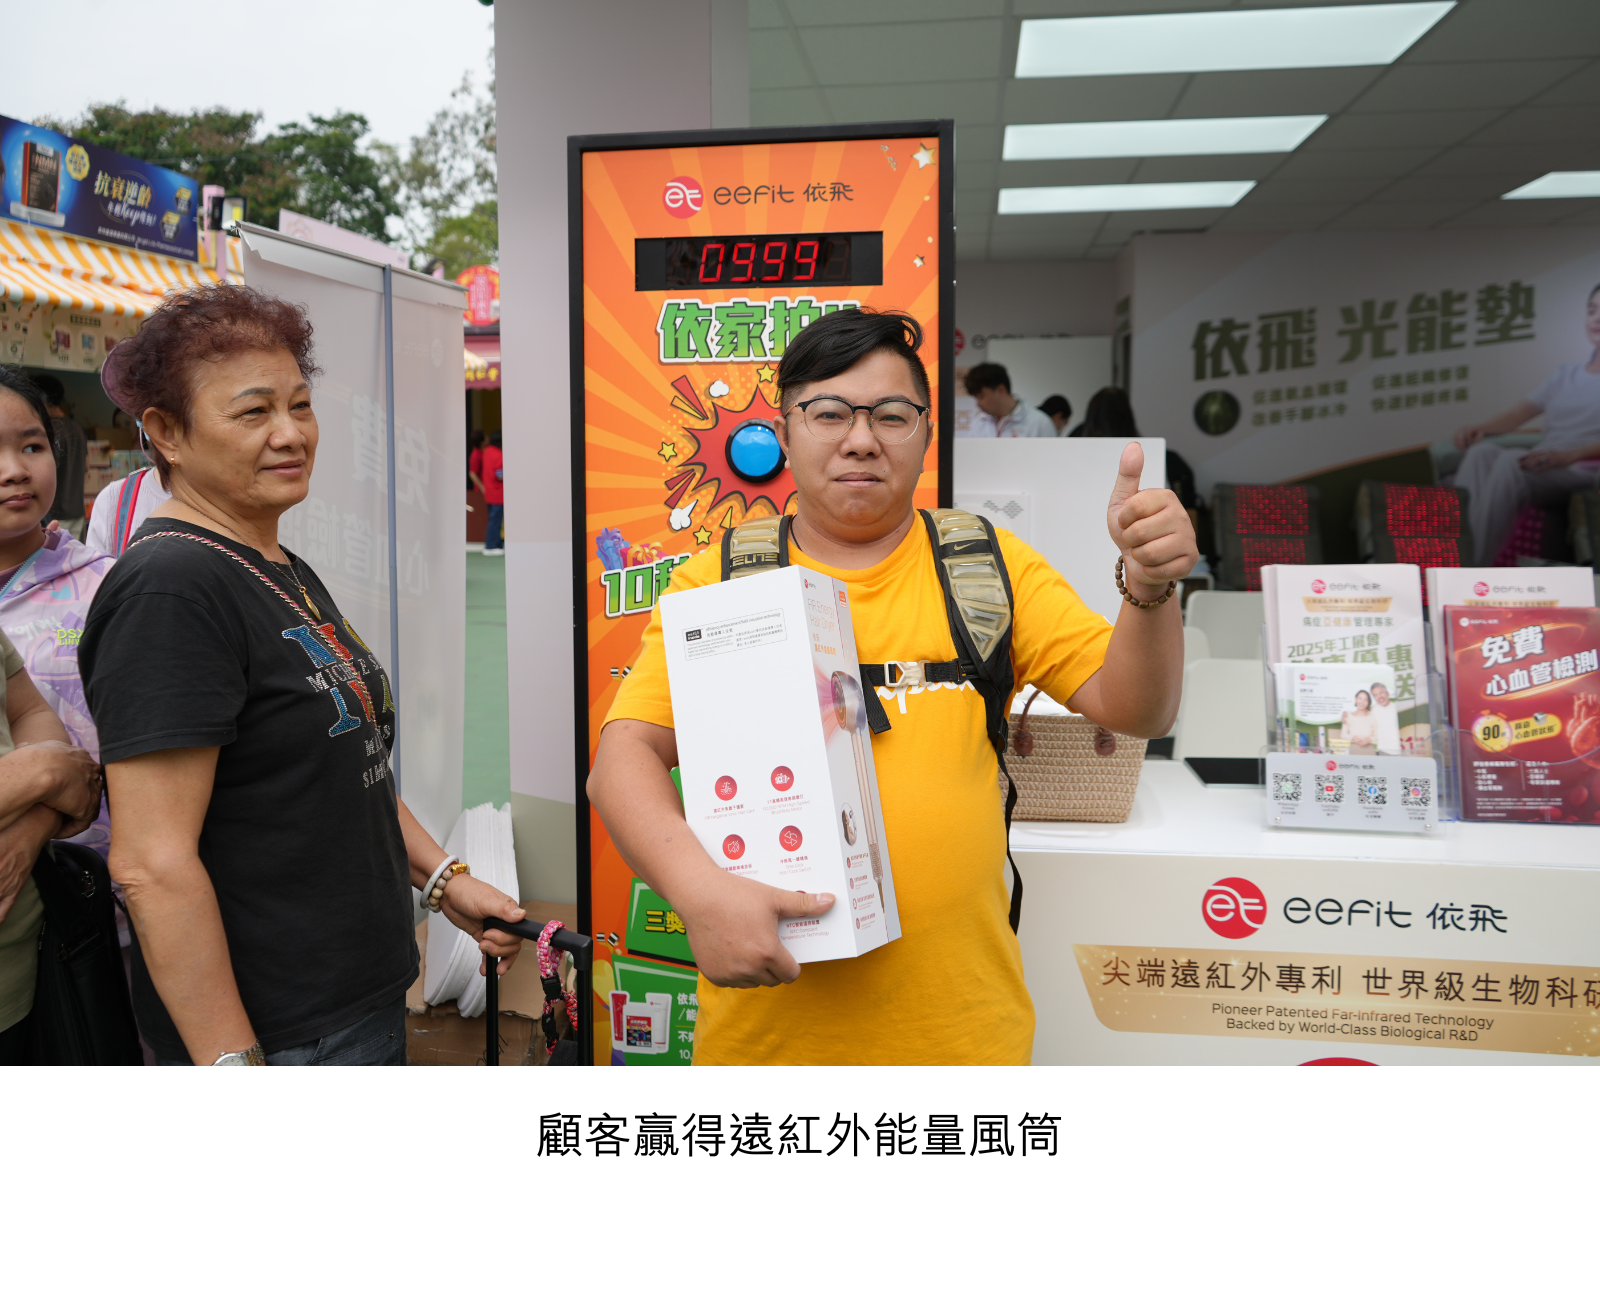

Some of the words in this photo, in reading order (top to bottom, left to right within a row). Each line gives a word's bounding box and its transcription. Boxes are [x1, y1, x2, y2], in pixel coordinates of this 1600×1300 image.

[713, 184, 794, 206] eefit
[803, 181, 854, 203] 依飛
[1191, 305, 1317, 382] 依飛
[1337, 279, 1536, 365] 光能墊
[1480, 625, 1547, 670] 免費
[1485, 648, 1600, 697] 心血管檢測
[1283, 896, 1412, 928] eefit
[1426, 902, 1508, 934] 依飛
[1101, 955, 1343, 997] 尖端遠紅外專利
[1211, 1003, 1263, 1017] Pioneer
[1266, 1005, 1329, 1020] Patented
[1331, 1008, 1412, 1024] Far-Infrared
[1414, 1012, 1495, 1030] Technology
[1226, 1018, 1275, 1032] Backed
[1277, 1020, 1295, 1034] by
[1298, 1021, 1377, 1036] World-Class
[1380, 1024, 1446, 1041] Biological
[1448, 1028, 1479, 1042] R&D
